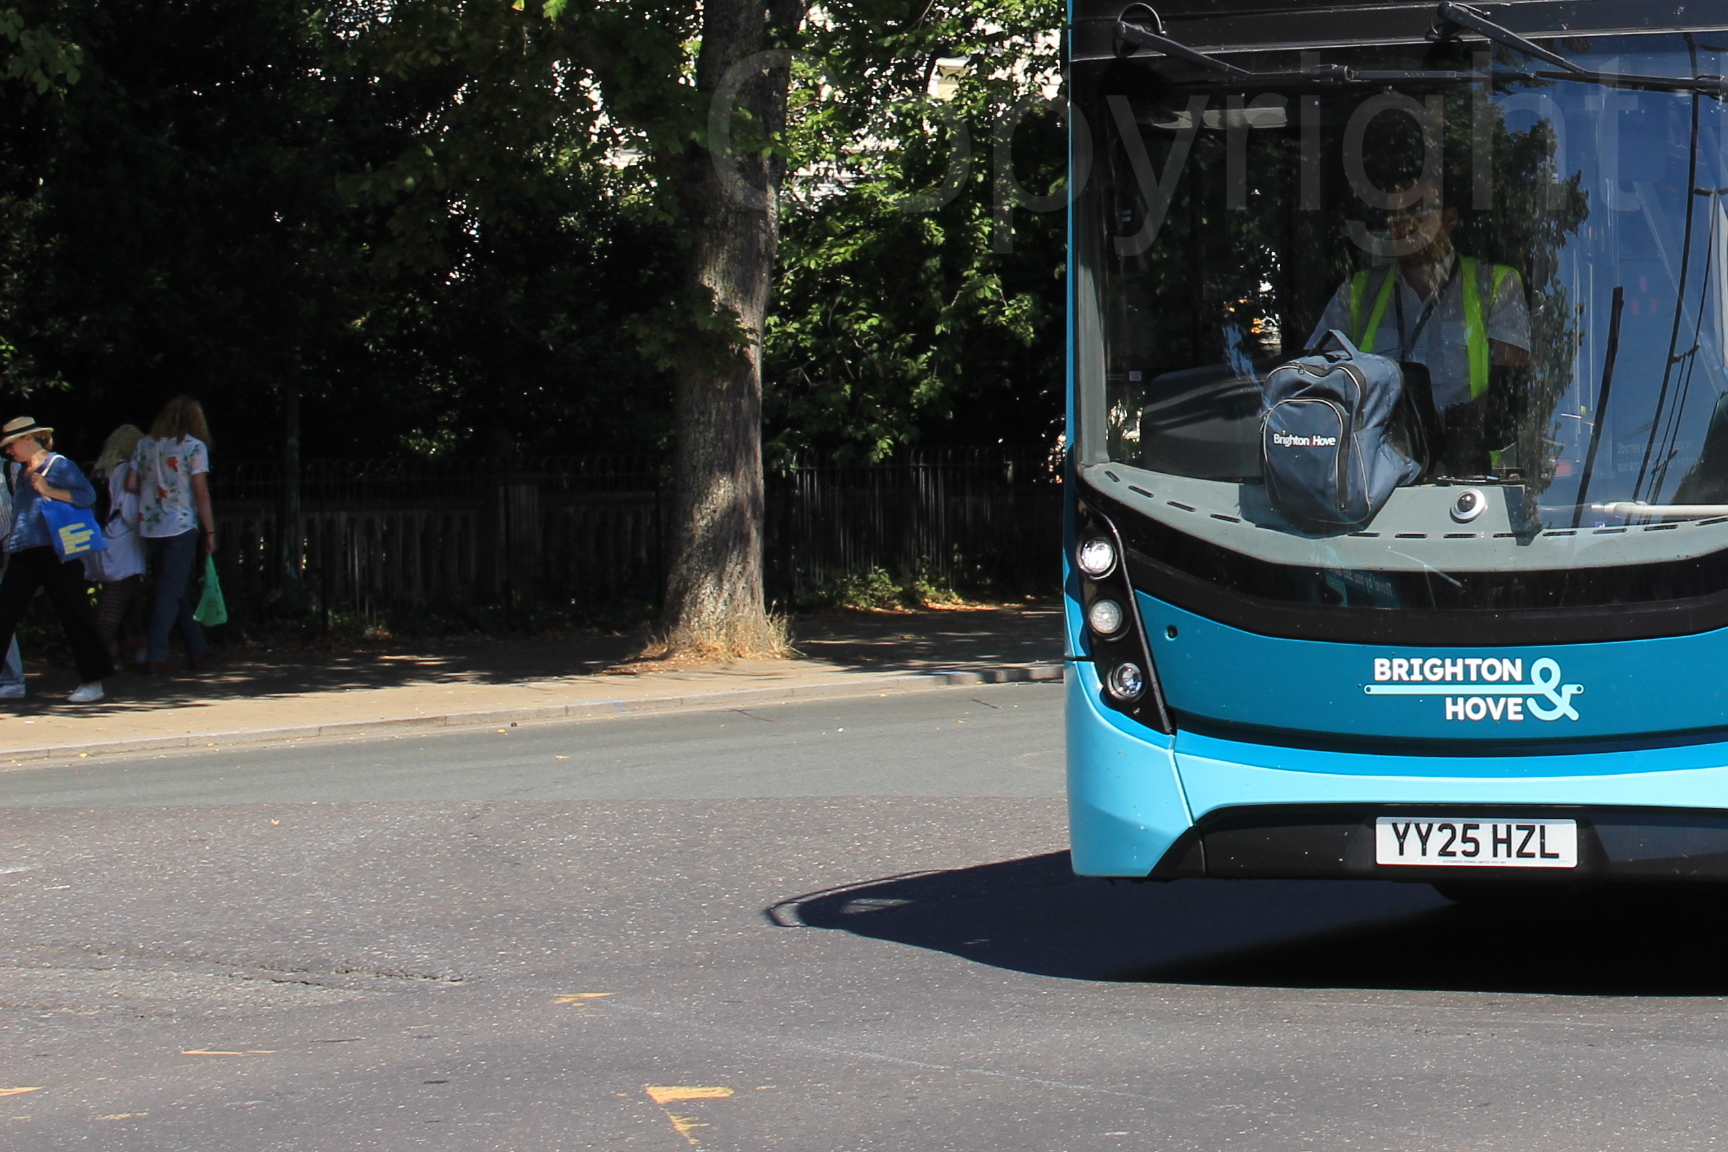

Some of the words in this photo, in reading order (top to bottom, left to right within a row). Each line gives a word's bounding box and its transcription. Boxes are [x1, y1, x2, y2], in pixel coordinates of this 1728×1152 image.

[1273, 431, 1310, 448] Brighton
[1313, 435, 1336, 446] Hove
[1373, 657, 1523, 682] BRIGHTON
[1445, 697, 1524, 721] HOVE
[1391, 822, 1480, 857] YY25
[1492, 824, 1560, 859] HZL
